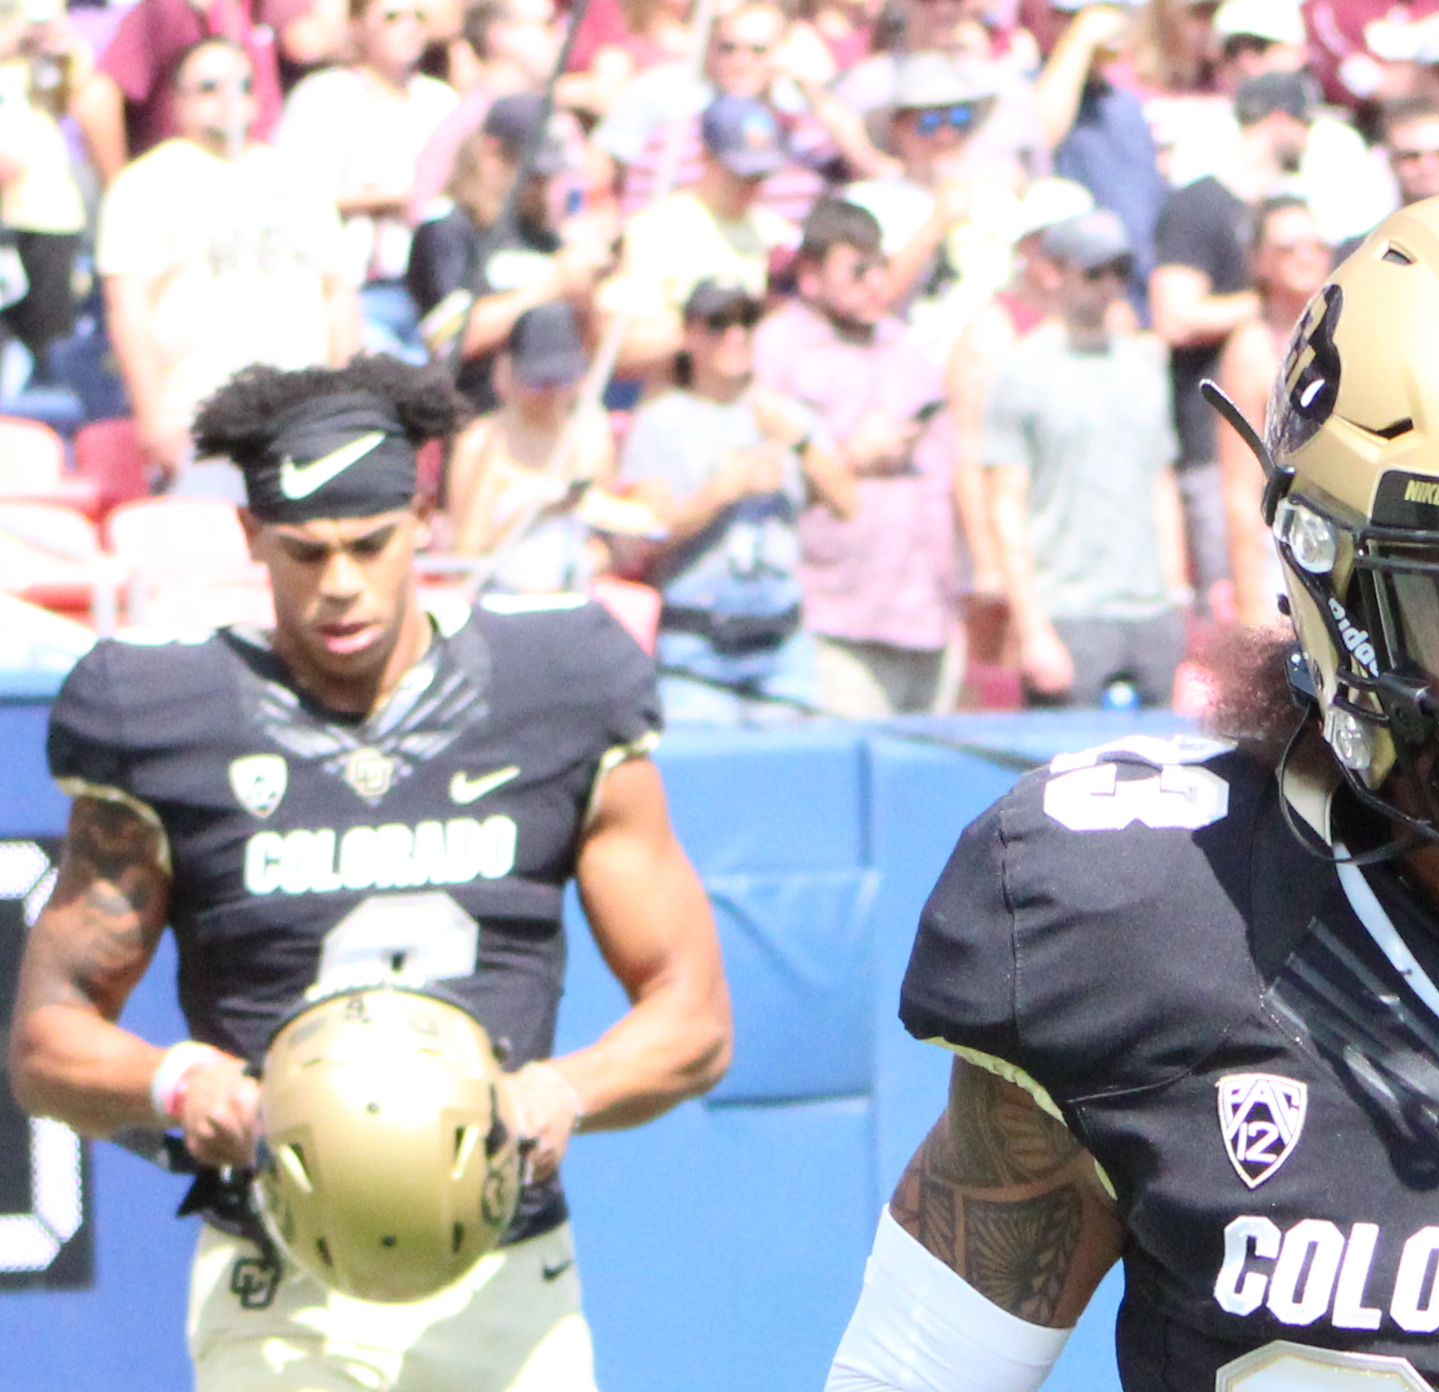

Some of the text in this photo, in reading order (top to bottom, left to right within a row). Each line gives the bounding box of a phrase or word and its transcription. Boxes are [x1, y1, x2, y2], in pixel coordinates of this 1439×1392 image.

[1328, 597, 1379, 678] Ridd
[243, 814, 518, 895] COLORADO
[1236, 1120, 1280, 1163] 12
